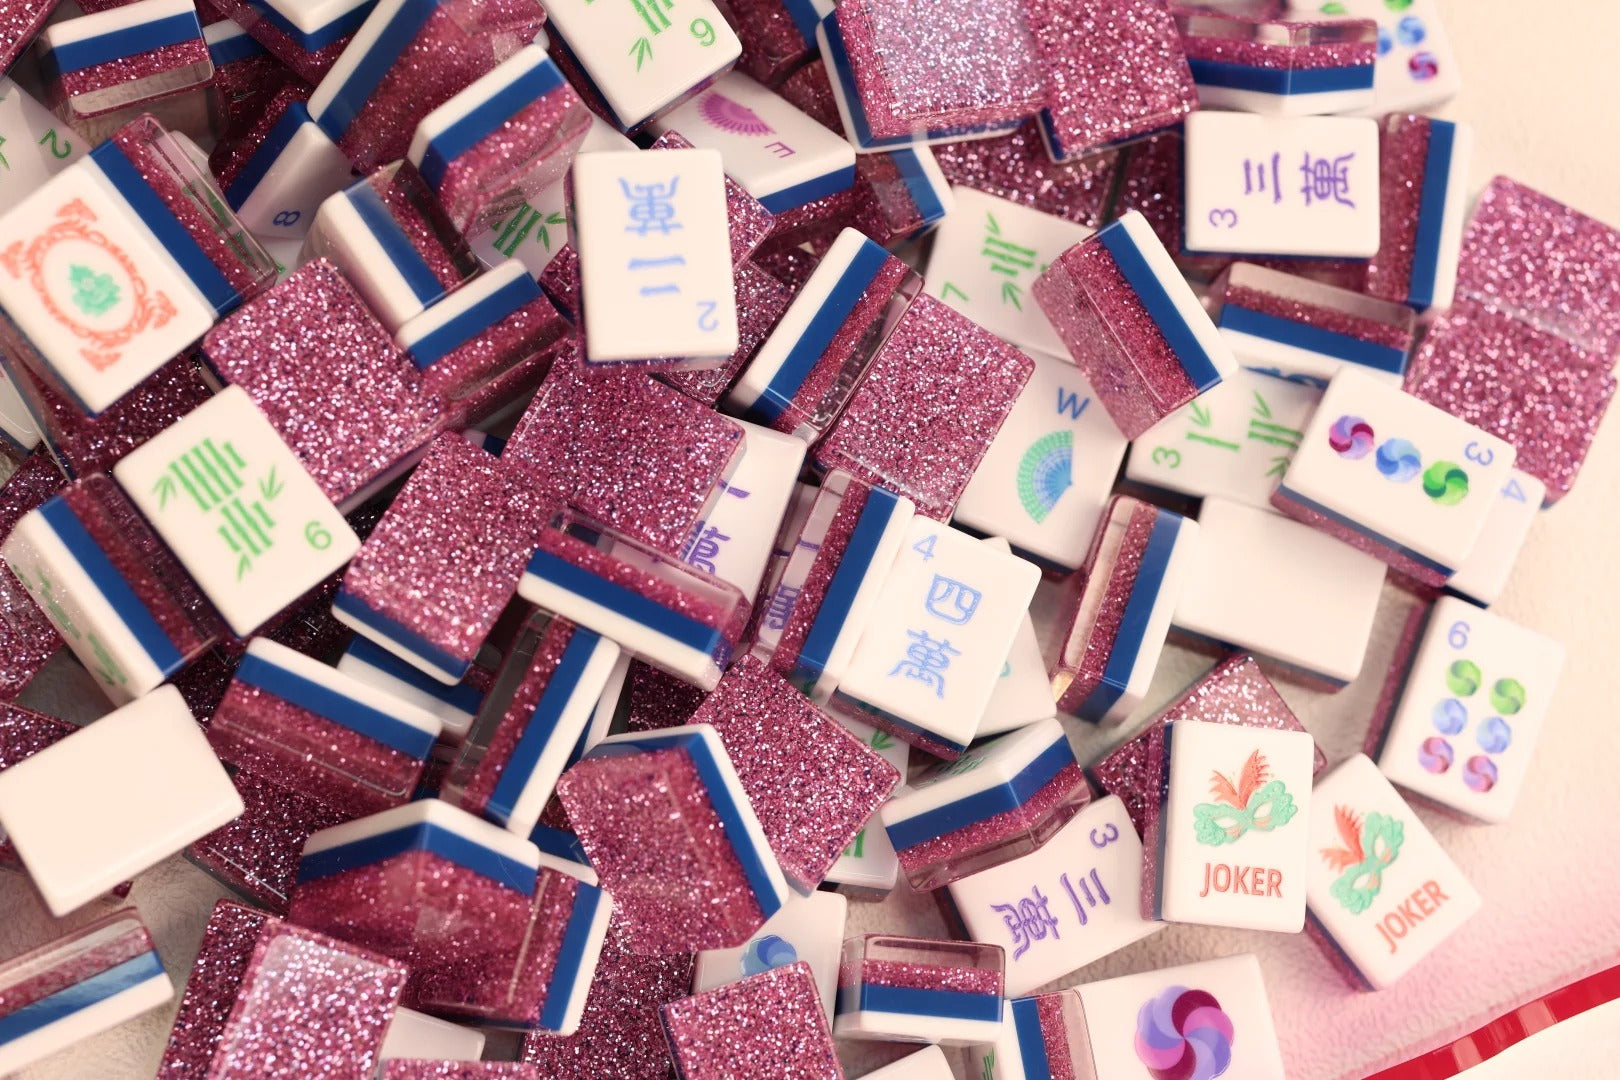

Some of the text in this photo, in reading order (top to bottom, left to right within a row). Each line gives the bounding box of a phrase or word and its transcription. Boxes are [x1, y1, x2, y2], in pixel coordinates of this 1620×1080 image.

[273, 210, 300, 226] 8
[1209, 208, 1238, 228] 3
[696, 300, 719, 332] 2
[1152, 445, 1182, 469] 3
[1464, 441, 1494, 466] 3
[913, 534, 938, 562] 4
[1090, 823, 1119, 848] 3
[1199, 862, 1283, 898] JOKER
[1375, 879, 1450, 955] JOKER
